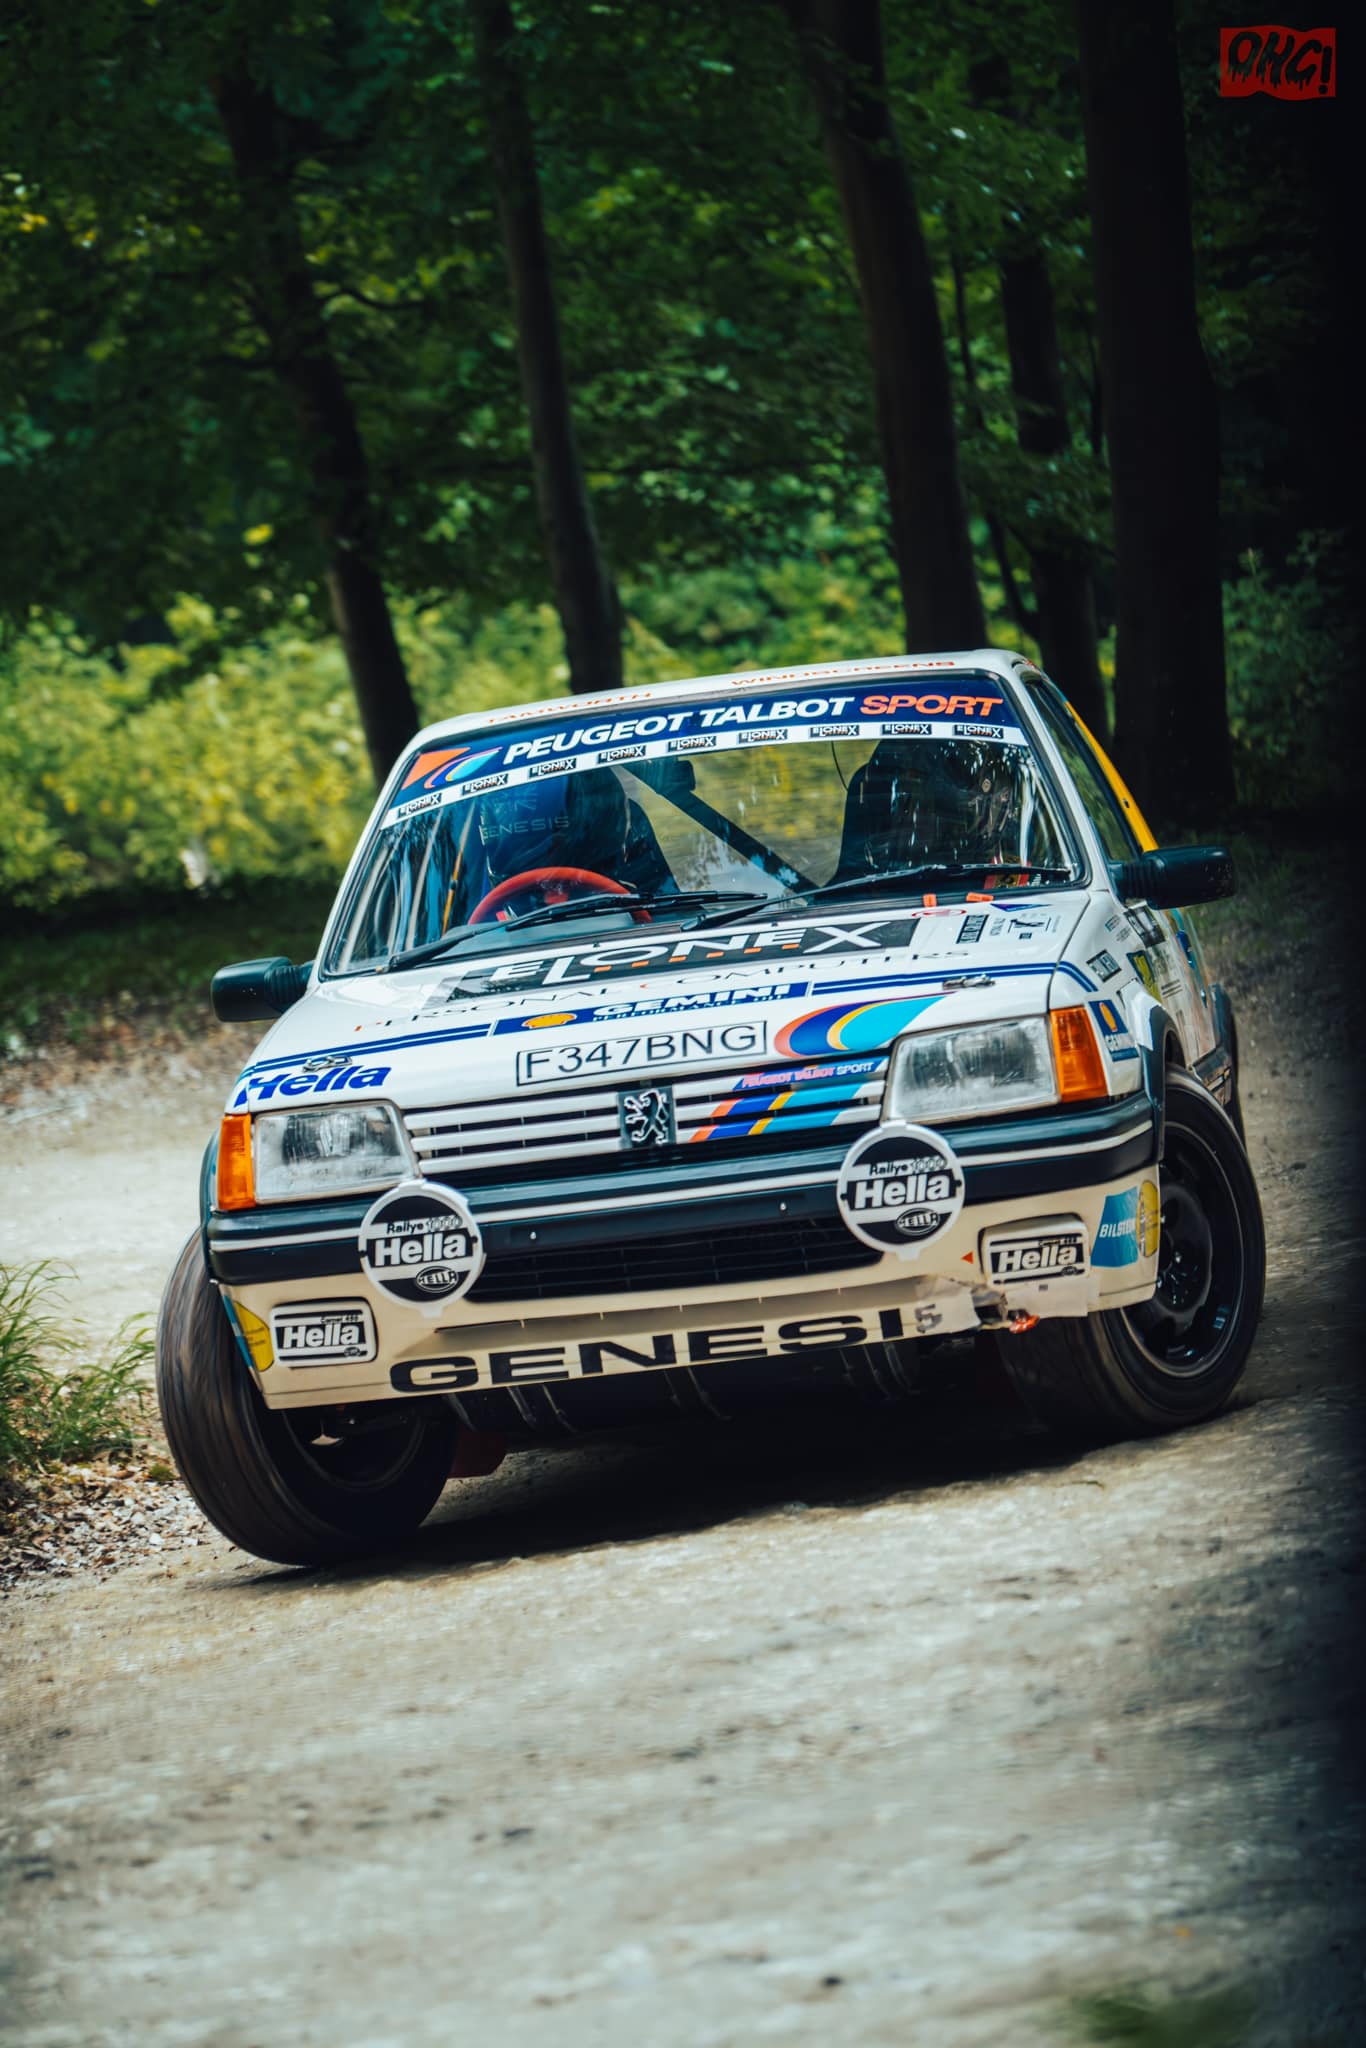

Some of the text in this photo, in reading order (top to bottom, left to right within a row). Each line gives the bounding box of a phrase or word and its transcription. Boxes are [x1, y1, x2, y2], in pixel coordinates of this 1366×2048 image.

[503, 694, 1003, 765] PEUGEOT TALBOT SPORT
[740, 728, 788, 744] ELONEX
[811, 724, 859, 738] ELONEX
[882, 723, 932, 736] ELONEX
[954, 724, 1004, 739] ELONEX
[600, 744, 646, 764] ELONEX
[669, 734, 716, 752] ELONEX
[530, 758, 576, 779] ELONEX
[463, 774, 508, 796] ELONEX
[398, 793, 442, 818] ELONEX
[489, 920, 892, 985] ELONEX
[592, 983, 790, 1017] GEMINI
[526, 1025, 757, 1079] F347BNG
[836, 1061, 875, 1075] SPORT
[234, 1064, 392, 1108] Hella
[870, 1160, 908, 1177] Rallye
[854, 1174, 951, 1210] Hella
[387, 1220, 424, 1236] Rallye
[375, 1232, 467, 1267] Hella
[998, 1244, 1077, 1273] Hella
[282, 1323, 361, 1349] Hella
